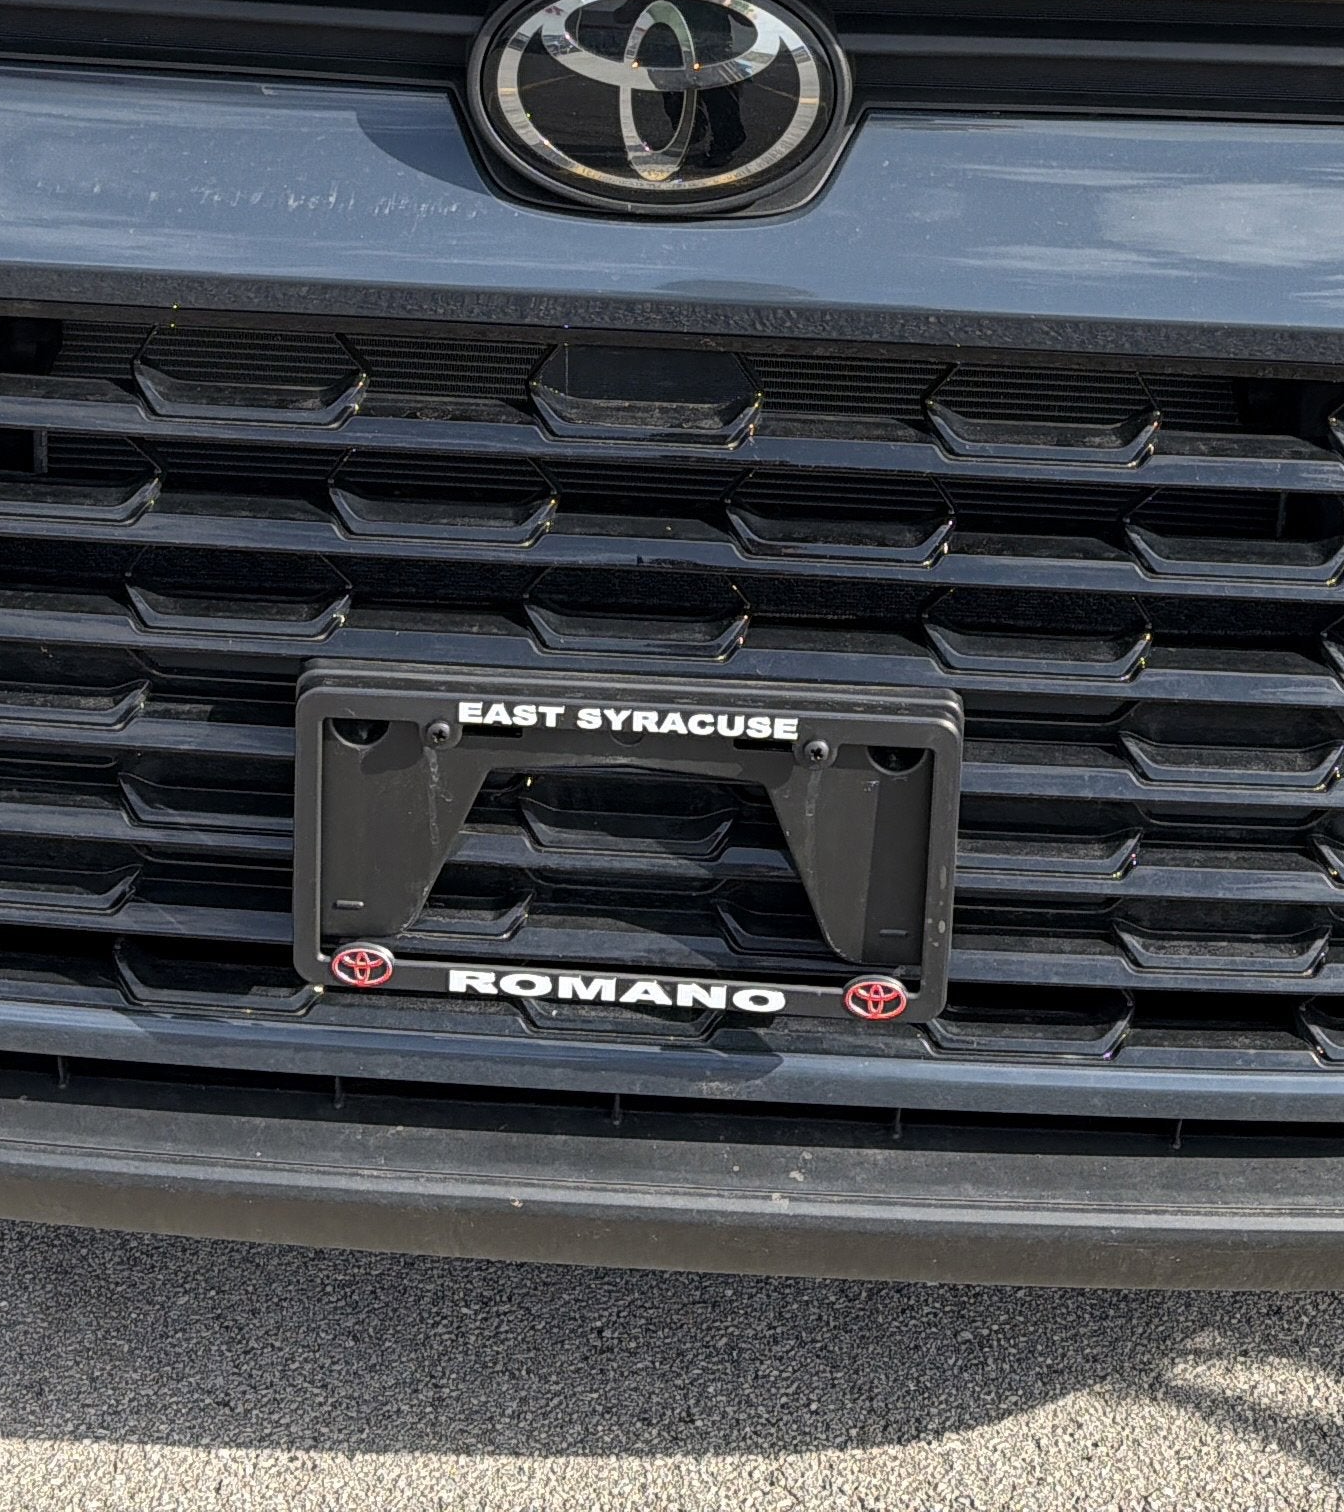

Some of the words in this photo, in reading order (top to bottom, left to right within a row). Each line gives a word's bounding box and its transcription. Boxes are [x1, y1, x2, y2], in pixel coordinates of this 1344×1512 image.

[458, 701, 565, 728] EAST
[576, 708, 799, 741] SYRACUSE
[448, 969, 787, 1013] ROMANO
